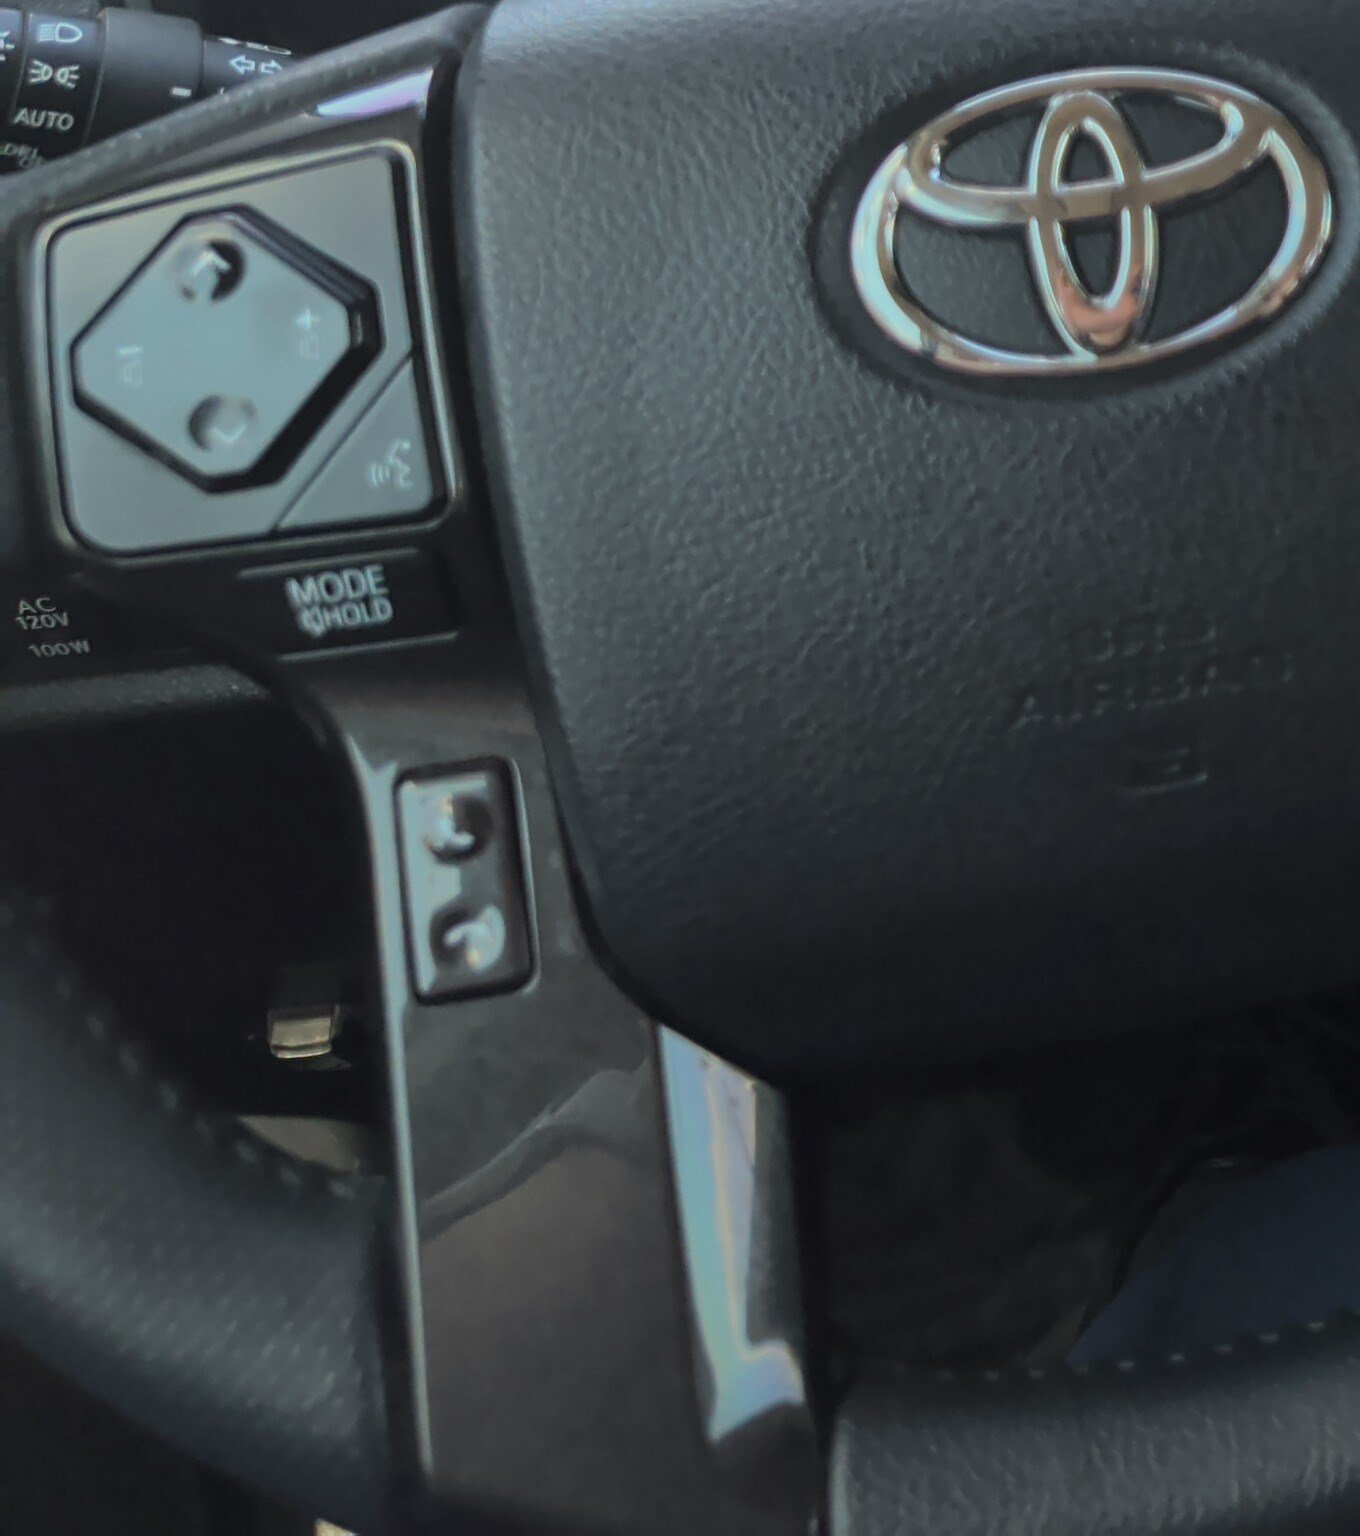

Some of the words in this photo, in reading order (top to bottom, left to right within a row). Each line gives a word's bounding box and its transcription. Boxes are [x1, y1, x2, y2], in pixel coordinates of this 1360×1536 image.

[13, 107, 75, 132] AUTO
[285, 563, 391, 607] MODE
[18, 596, 57, 616] AC
[322, 596, 394, 629] HOLD
[15, 611, 70, 631] 120V
[28, 638, 91, 659] 100W
